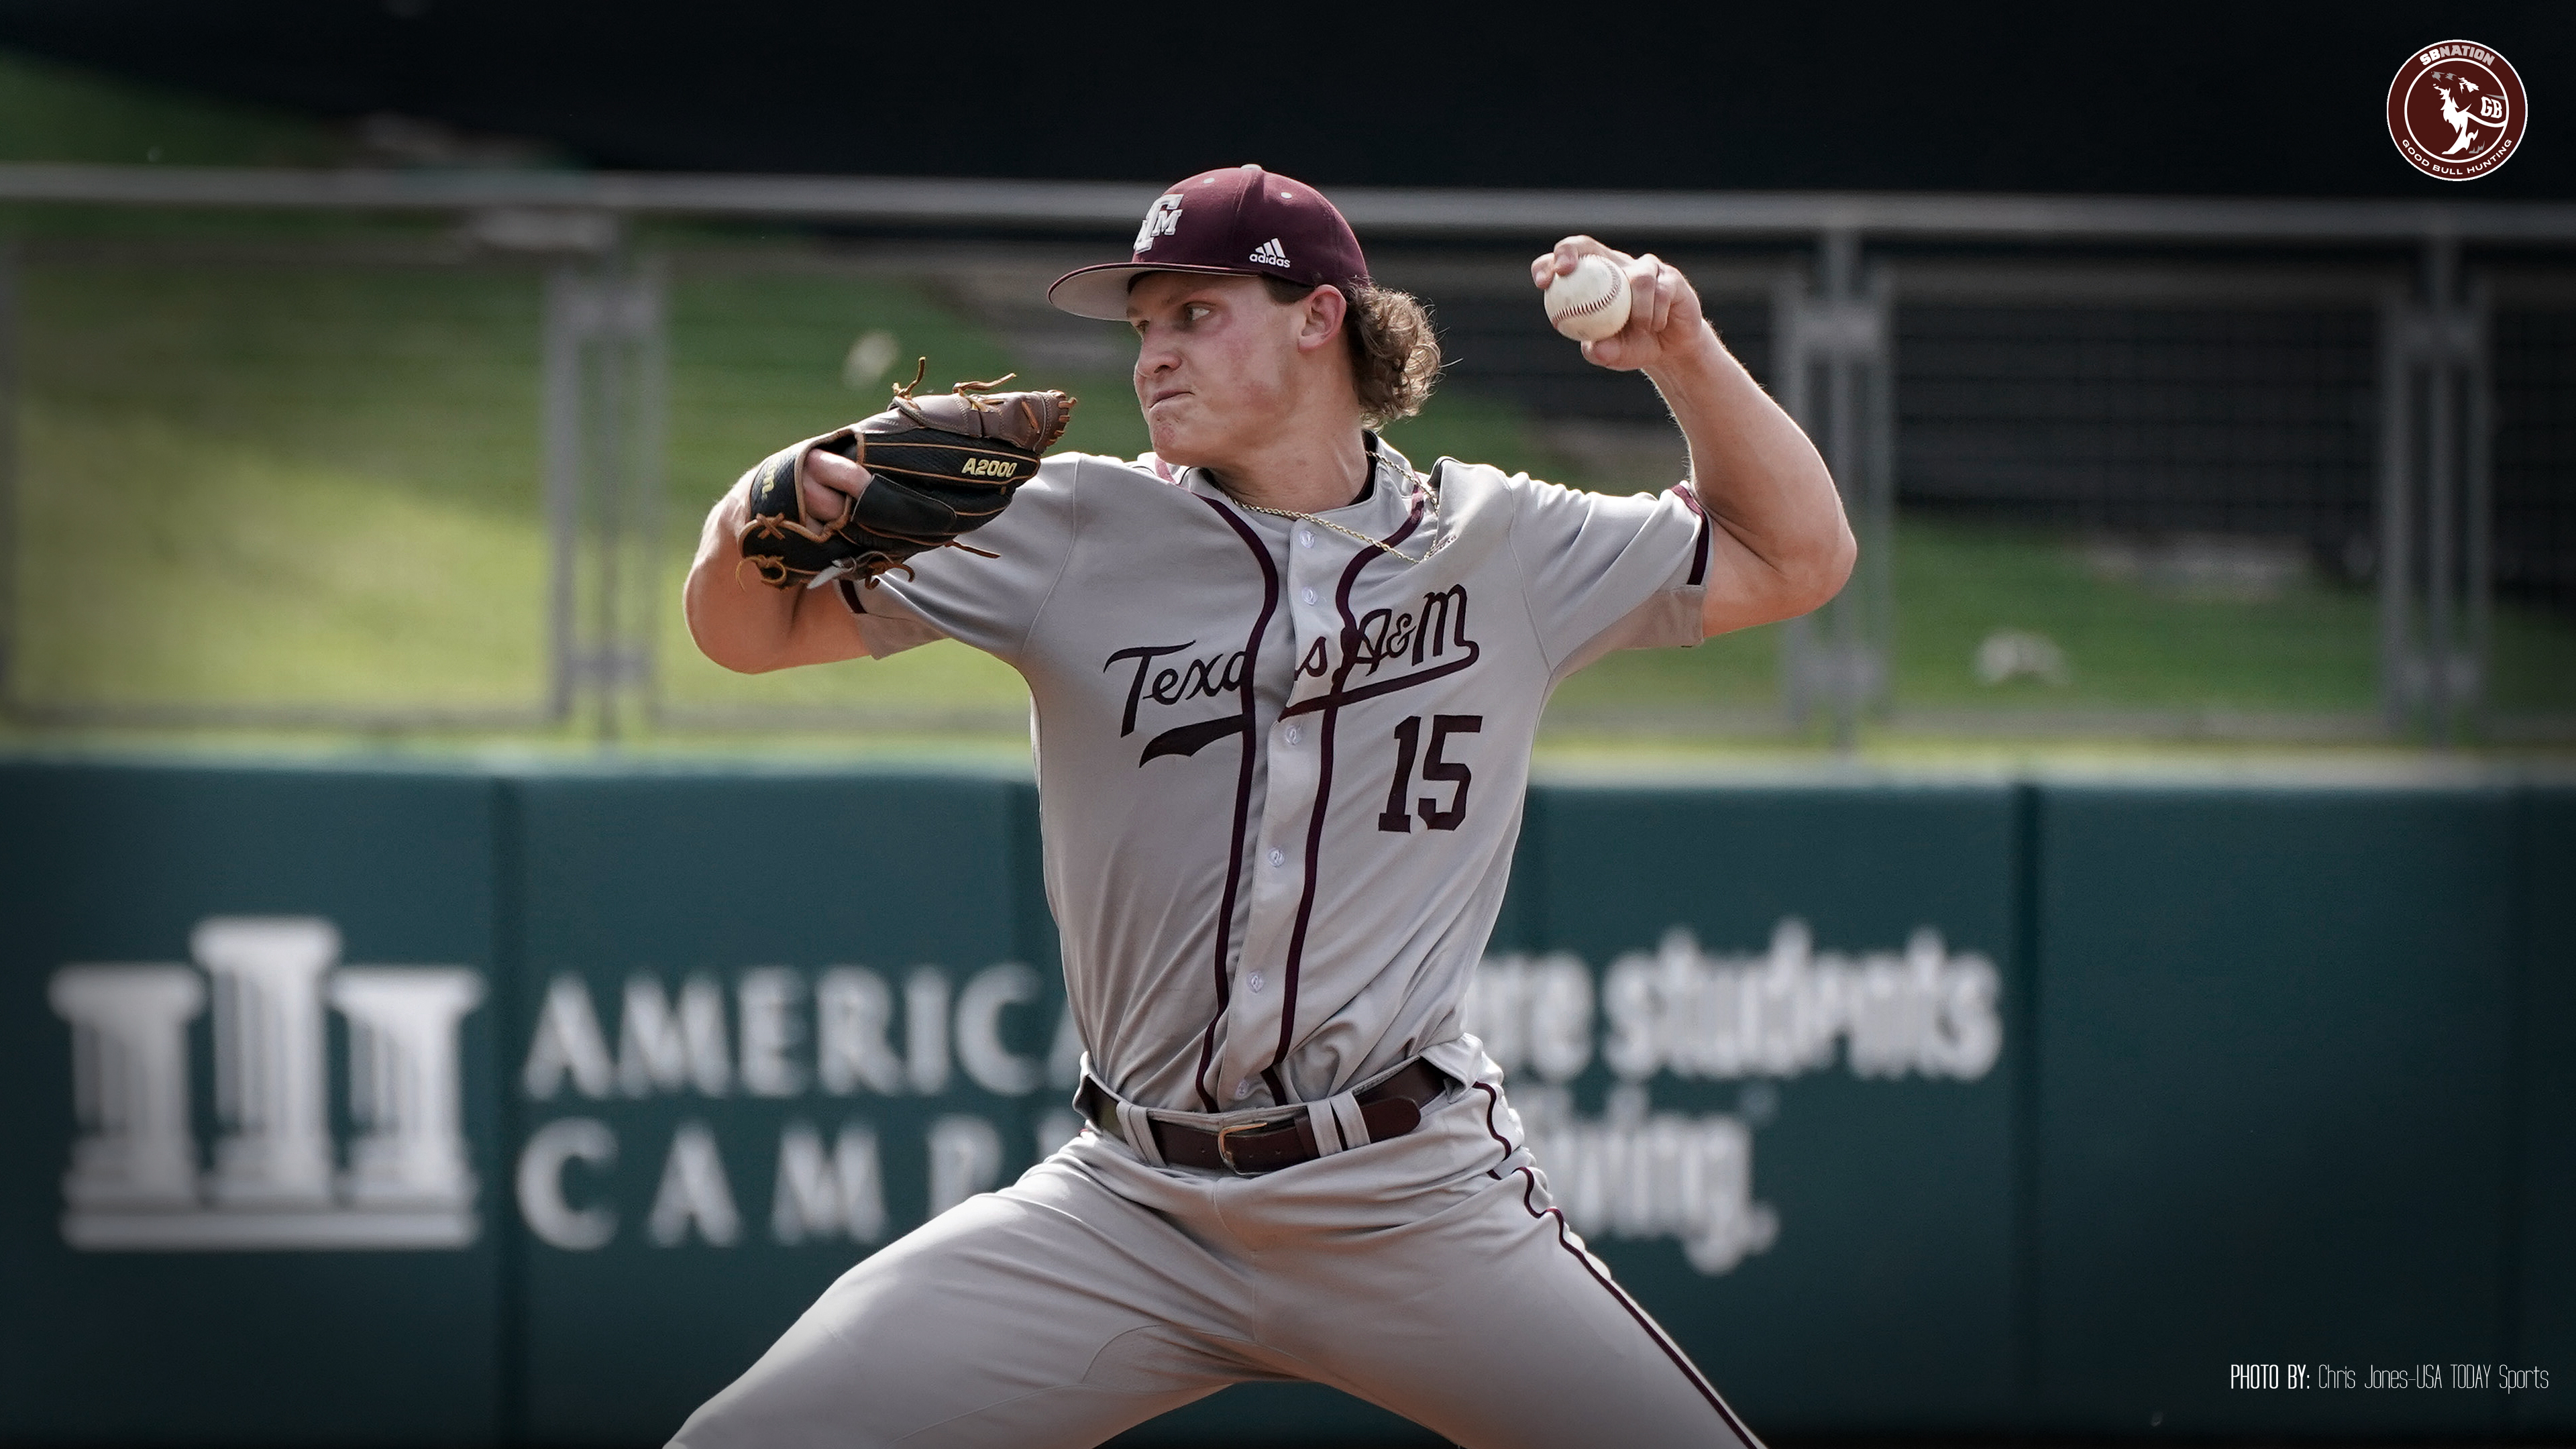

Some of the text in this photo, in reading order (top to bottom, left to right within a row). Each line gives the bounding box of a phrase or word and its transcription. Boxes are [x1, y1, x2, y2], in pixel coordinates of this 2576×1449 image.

[1249, 253, 1291, 268] adidas
[961, 458, 1018, 478] A2000
[1103, 583, 1481, 739] Texas A&M
[1378, 714, 1483, 834] 15
[515, 1115, 1081, 1250] CAMP
